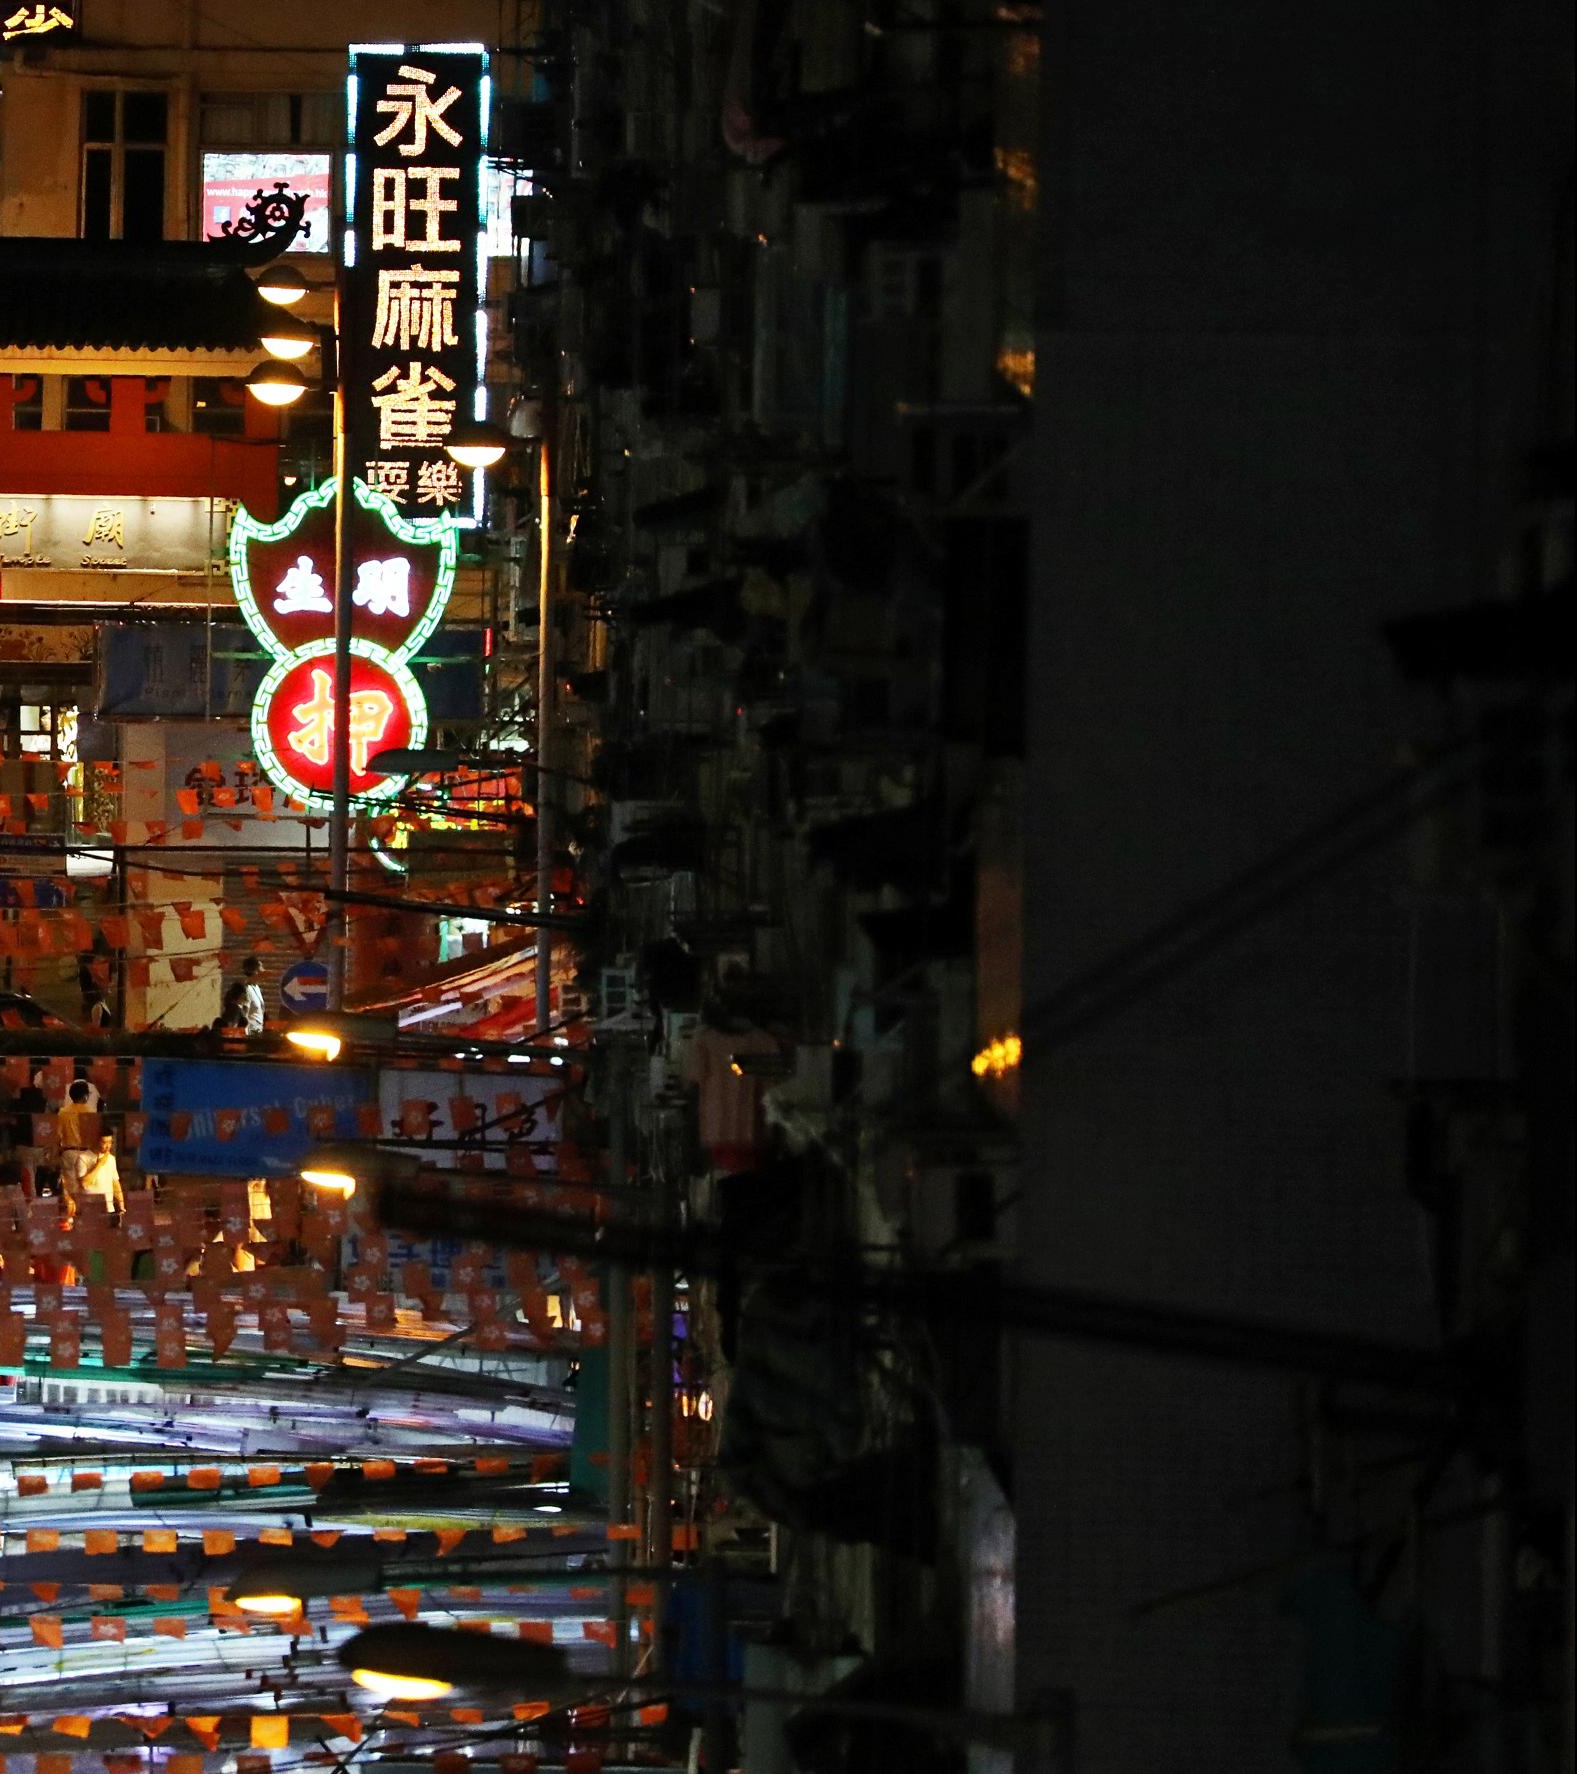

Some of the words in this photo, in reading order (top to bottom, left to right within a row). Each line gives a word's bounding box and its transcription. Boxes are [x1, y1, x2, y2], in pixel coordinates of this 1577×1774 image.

[372, 65, 463, 449] 永旺麻雀
[287, 669, 394, 777] 押
